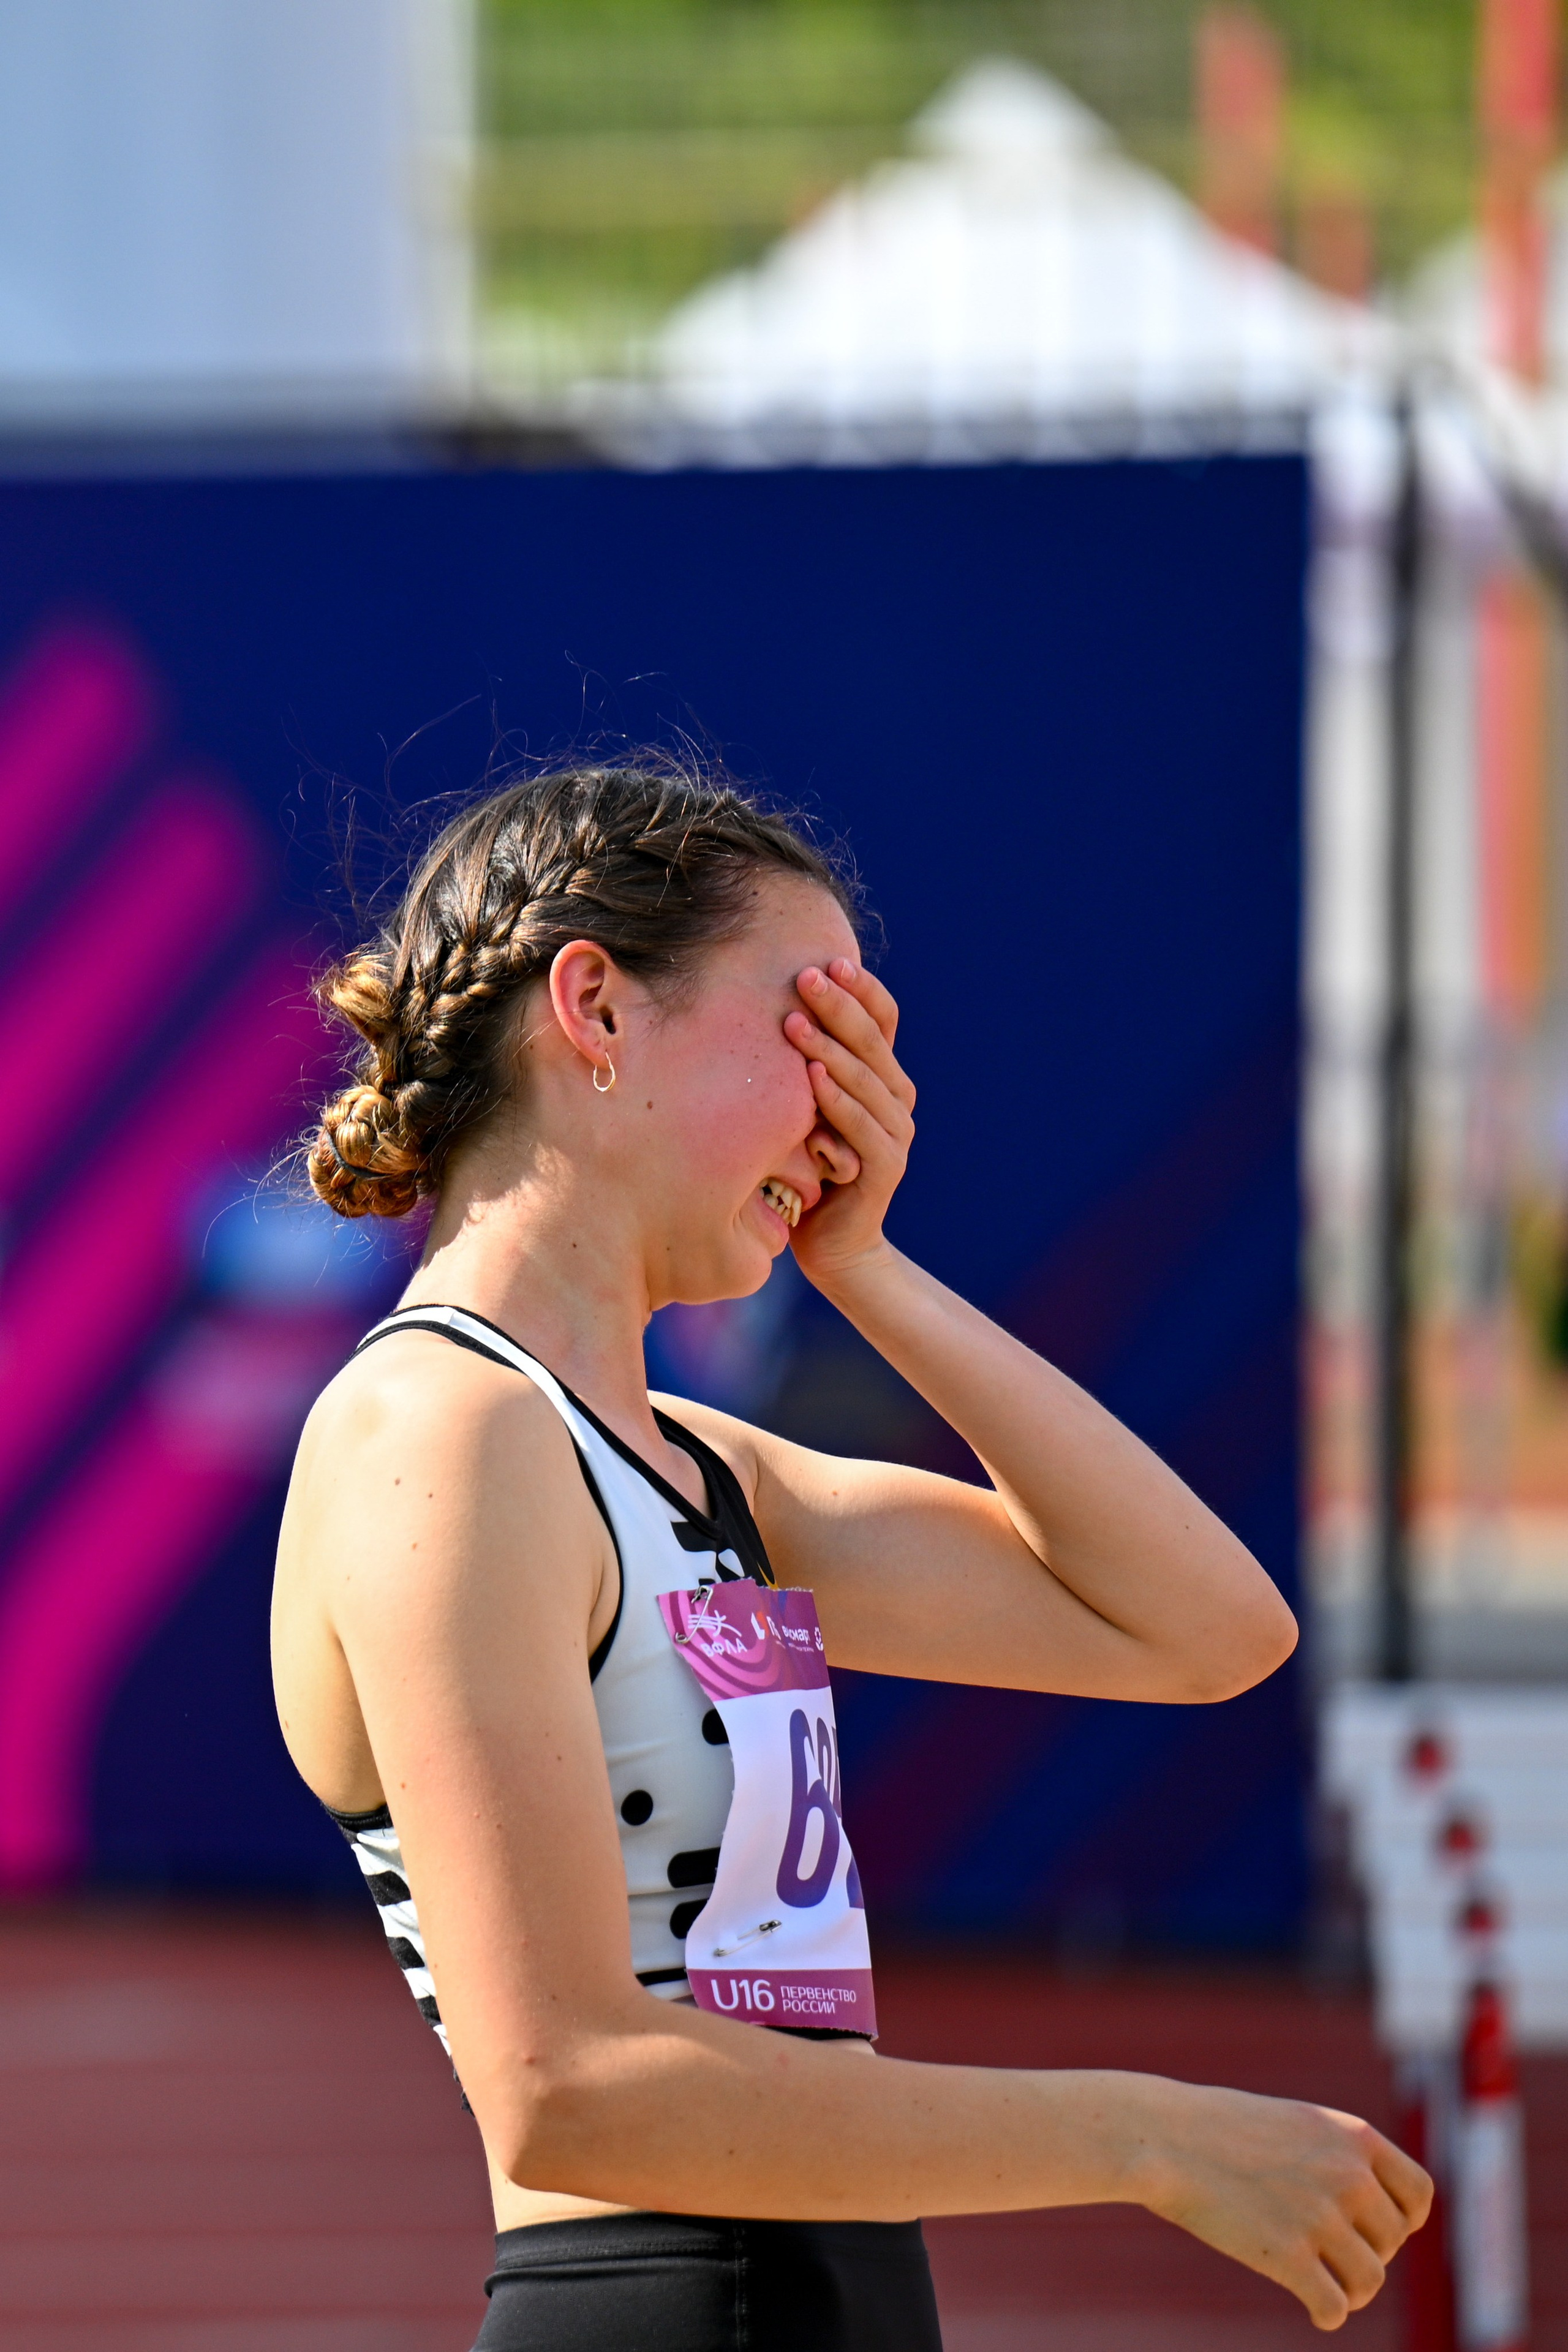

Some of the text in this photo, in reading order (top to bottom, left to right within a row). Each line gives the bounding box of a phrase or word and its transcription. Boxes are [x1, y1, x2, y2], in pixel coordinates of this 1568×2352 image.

[700, 1637, 747, 1657] ВФЛА
[710, 1979, 775, 2010] U16
[780, 1986, 856, 2003] ПЕРВЕНСТВО
[782, 1999, 835, 2014] РОССИИ
